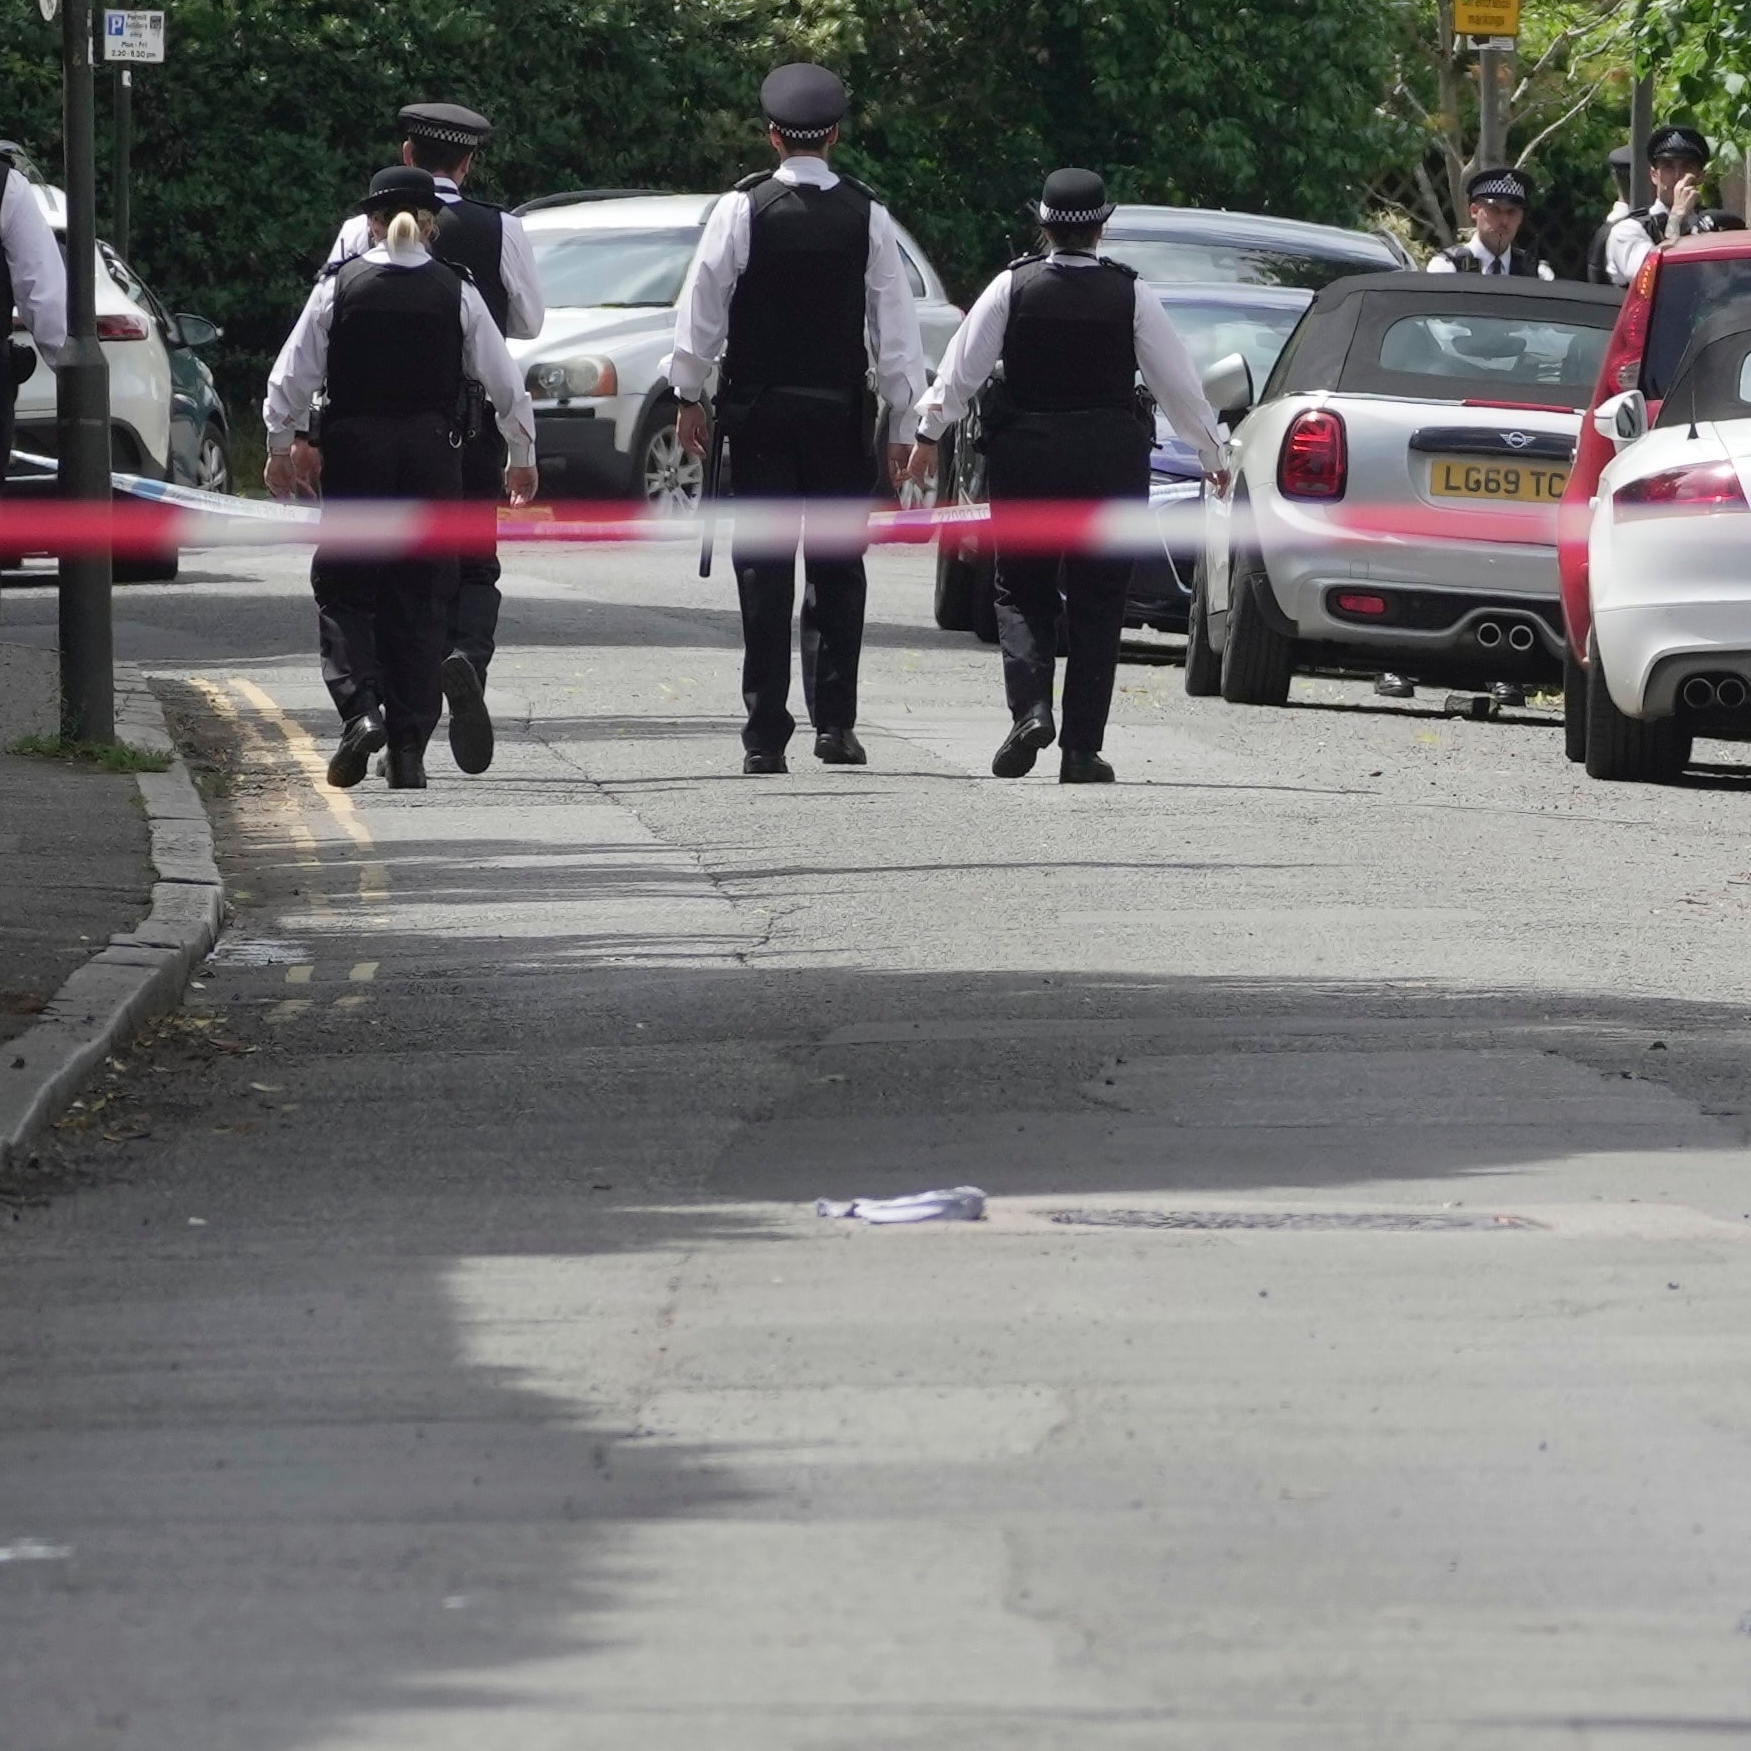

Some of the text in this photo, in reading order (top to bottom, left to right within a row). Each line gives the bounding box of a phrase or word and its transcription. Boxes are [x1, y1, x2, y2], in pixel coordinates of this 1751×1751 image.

[111, 17, 123, 35] P
[1444, 465, 1567, 499] LG69 TC
